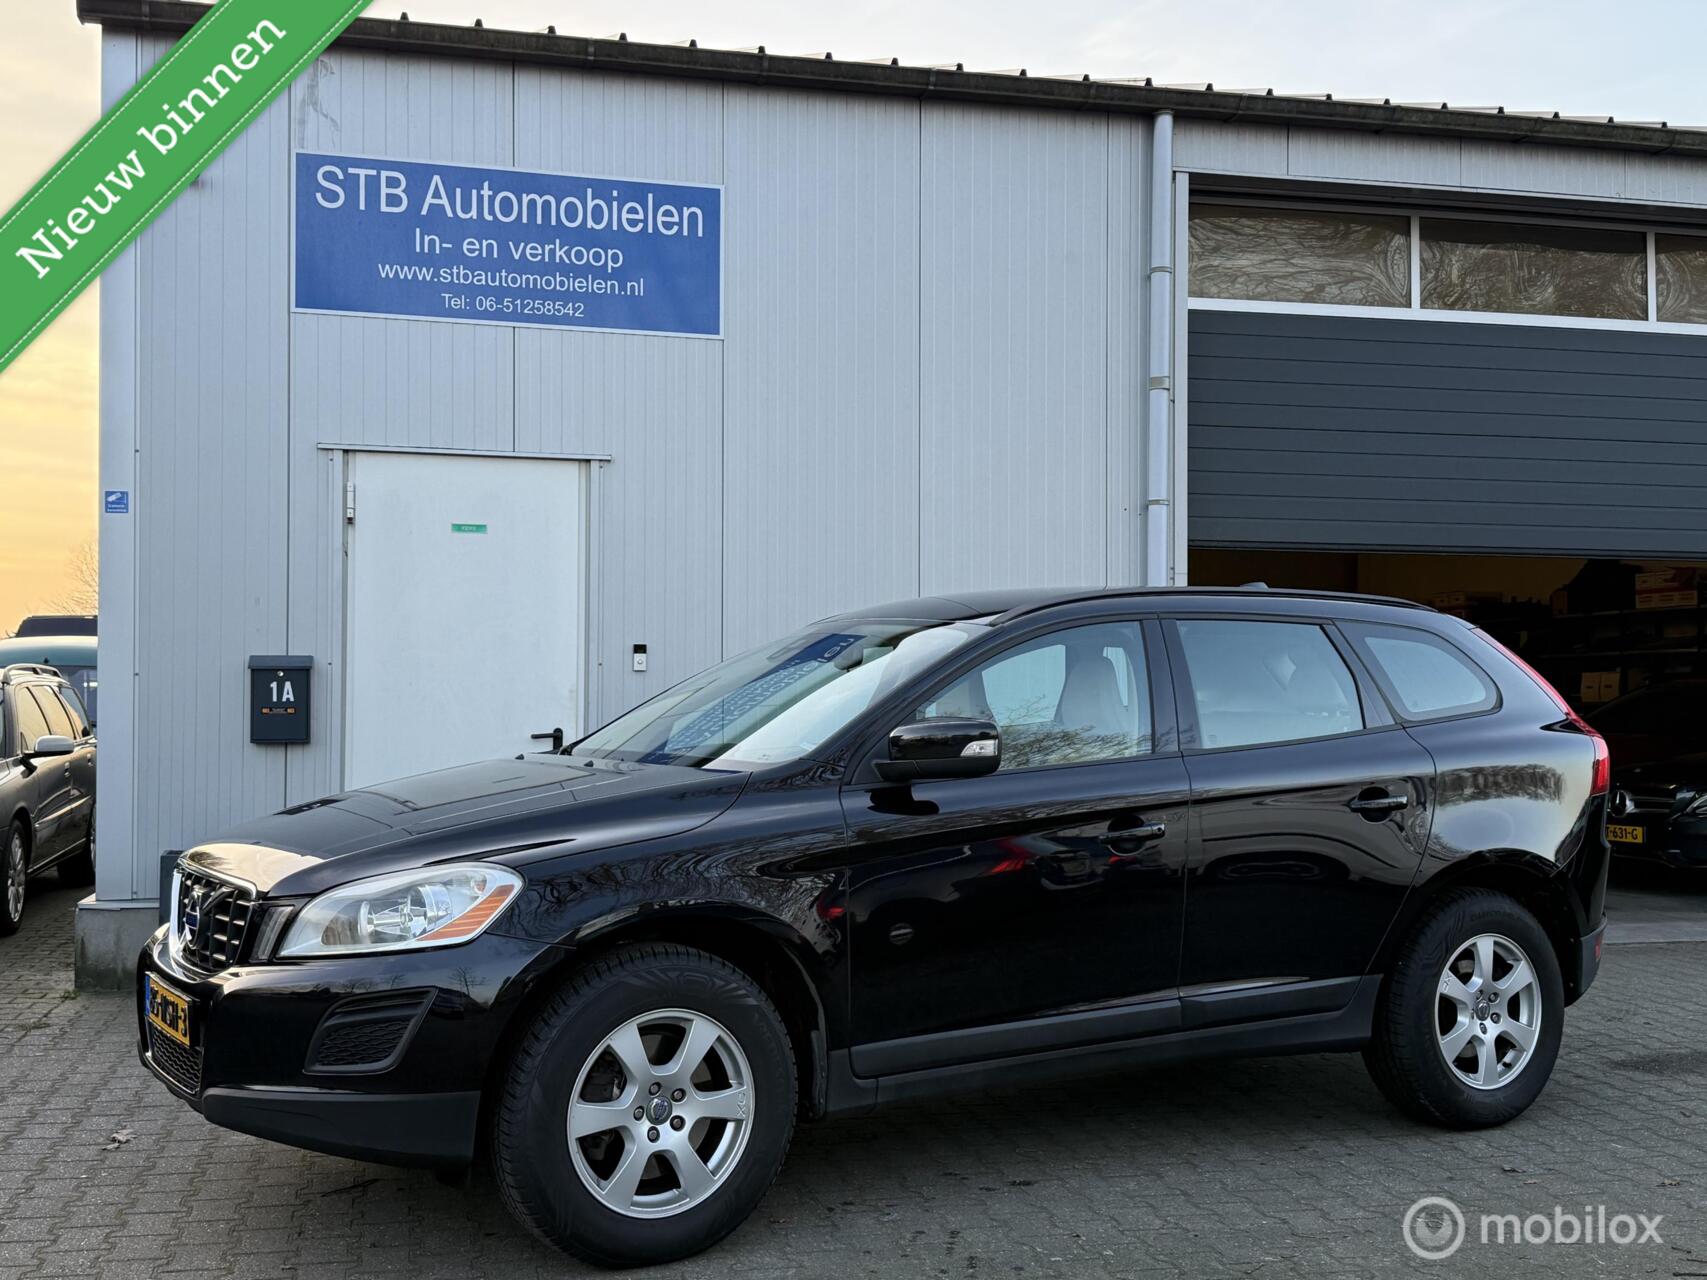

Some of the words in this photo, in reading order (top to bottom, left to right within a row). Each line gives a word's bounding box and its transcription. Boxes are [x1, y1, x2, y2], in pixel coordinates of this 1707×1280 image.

[314, 164, 409, 213] STB
[420, 174, 704, 237] Automobielen
[415, 228, 453, 253] In-
[462, 238, 498, 259] en
[508, 241, 624, 273] verkoop
[378, 263, 645, 297] www.stbautomobielen.nl
[441, 293, 470, 310] Tel:
[475, 295, 585, 317] 06-51258542
[270, 681, 295, 702] 1A
